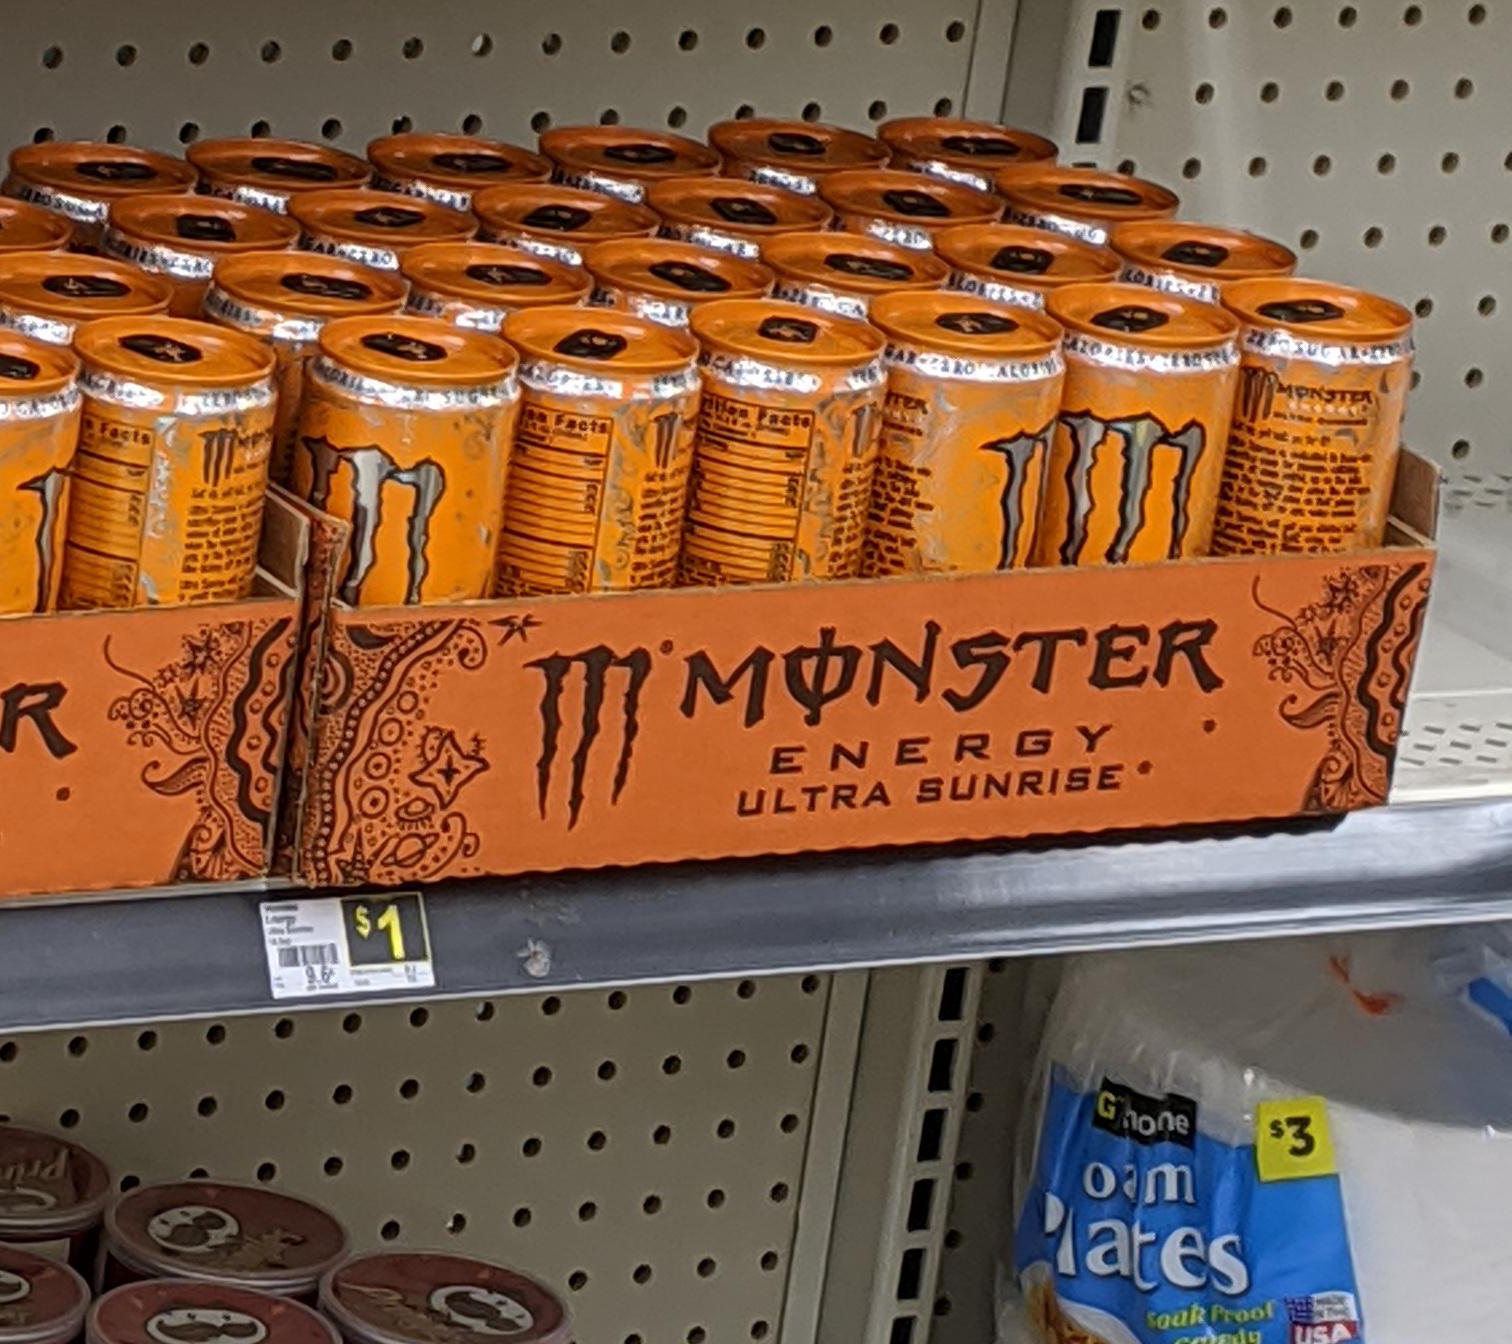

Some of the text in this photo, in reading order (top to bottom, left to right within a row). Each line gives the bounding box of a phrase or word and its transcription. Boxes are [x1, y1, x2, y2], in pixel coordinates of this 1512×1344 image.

[1277, 383, 1373, 406] MONSTER
[100, 422, 151, 446] Facts
[554, 414, 608, 434] Facts
[679, 618, 1226, 729] MONSTER
[769, 723, 1113, 775] ENERGY
[737, 764, 1123, 818] ULTRA SUNRISE
[355, 904, 405, 960] $1
[1269, 1116, 1316, 1158] $3
